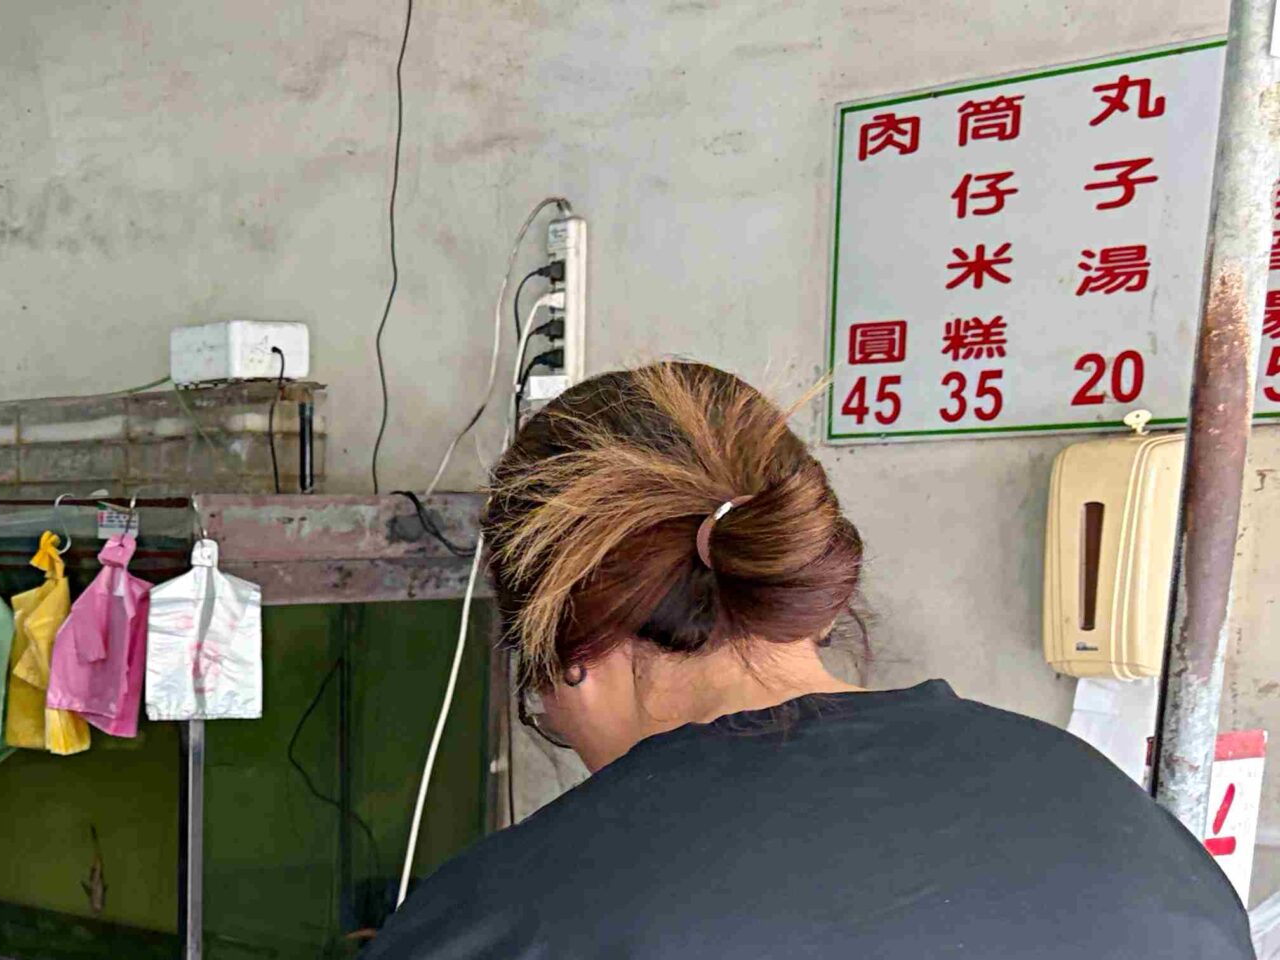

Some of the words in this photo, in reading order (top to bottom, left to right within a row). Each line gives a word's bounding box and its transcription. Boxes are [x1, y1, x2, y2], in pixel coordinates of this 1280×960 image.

[1075, 75, 1166, 296] 丸子湯
[941, 95, 1026, 361] 筒仔米糕
[841, 375, 902, 425] 45
[939, 369, 1004, 423] 35
[1070, 350, 1145, 406] 20
